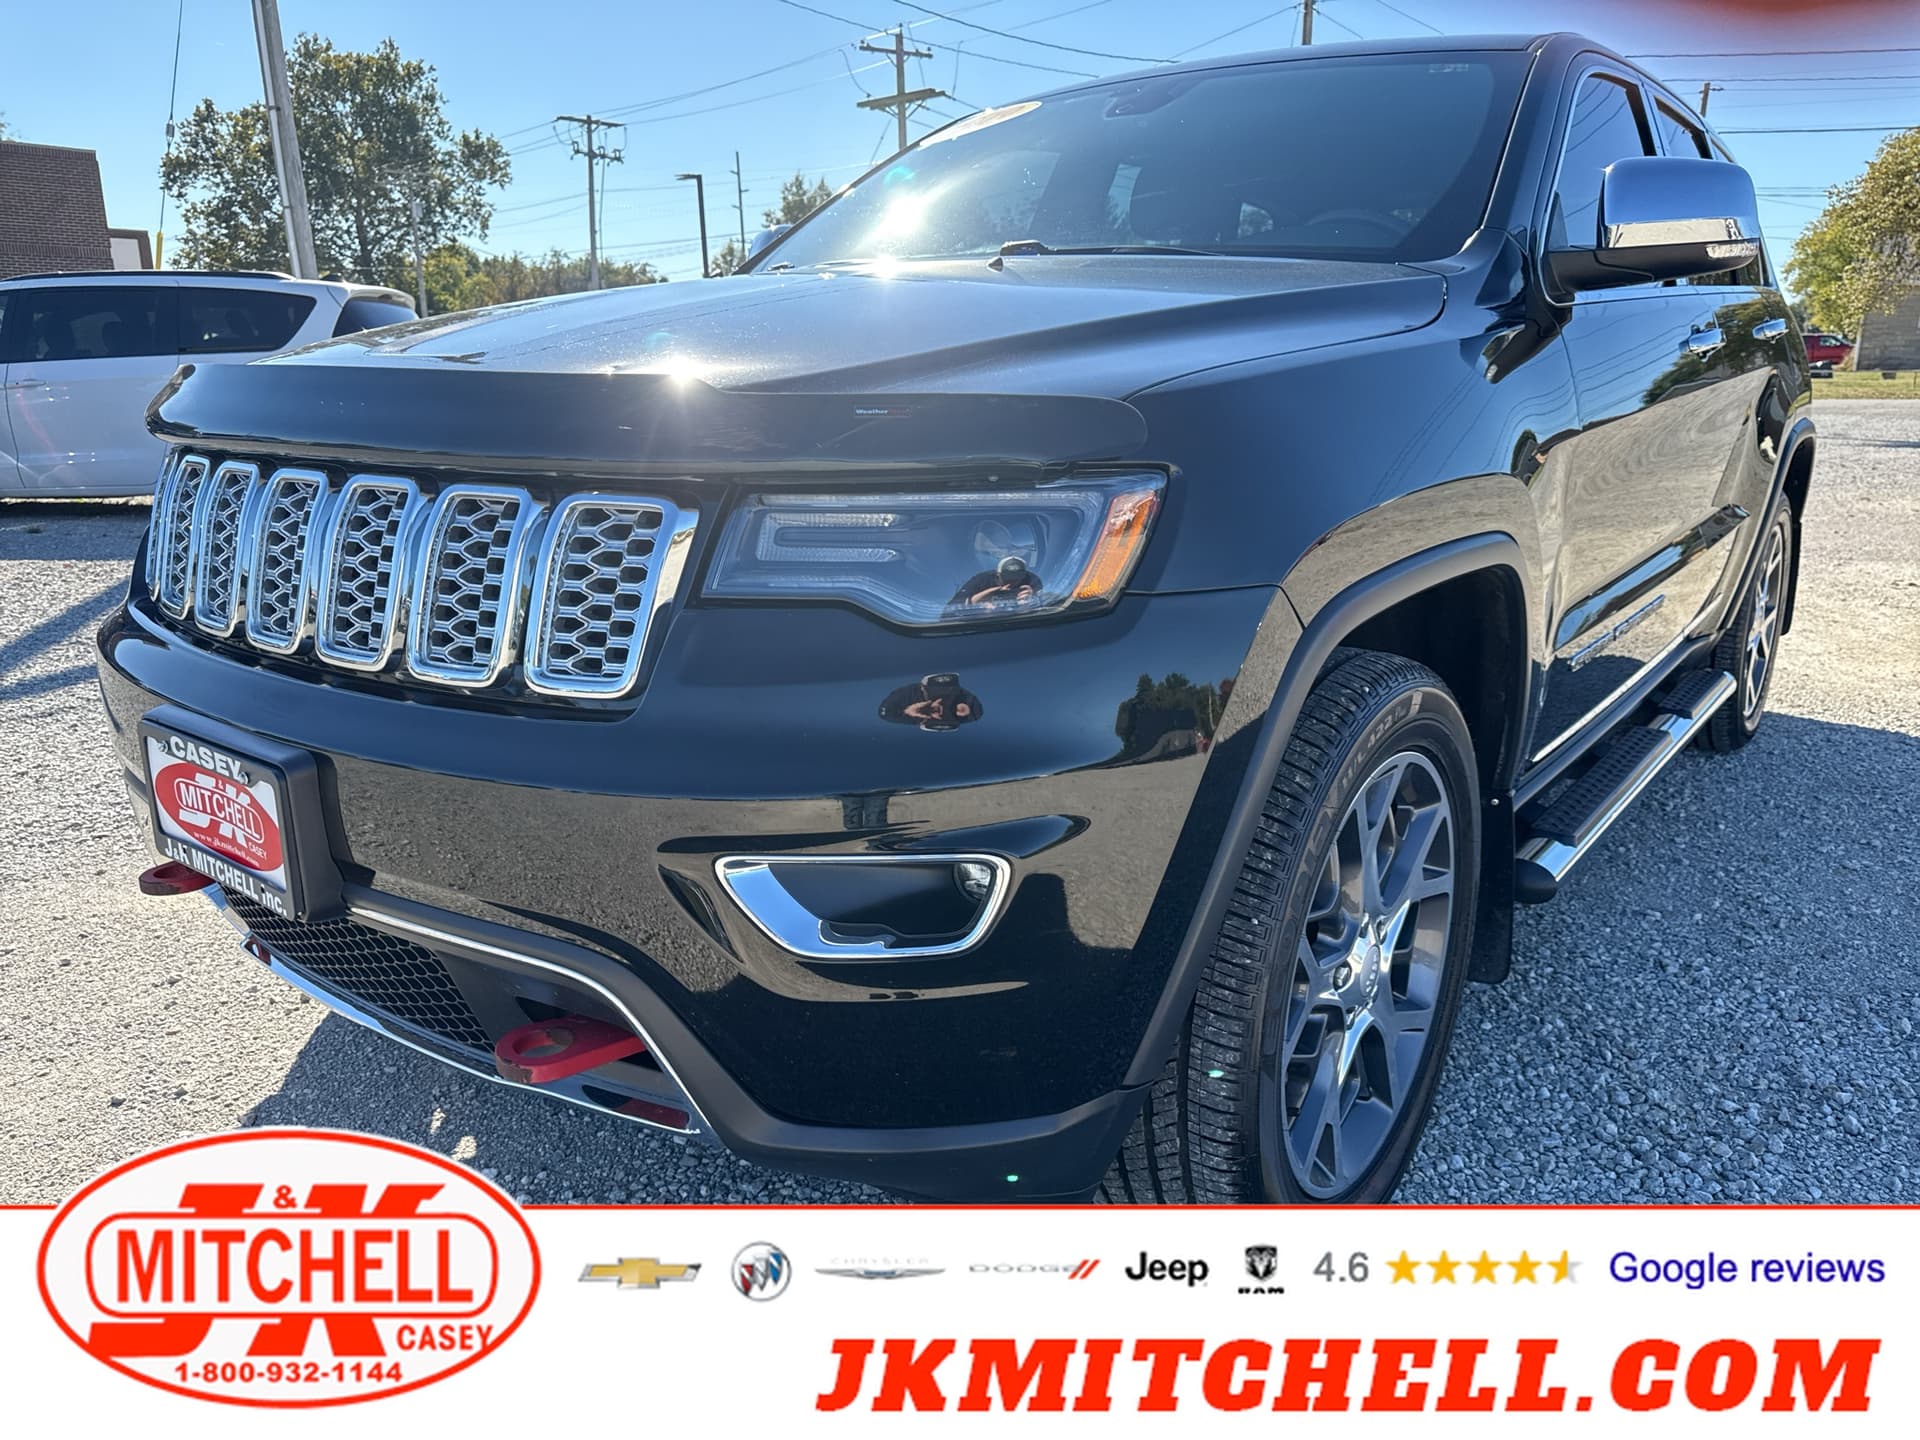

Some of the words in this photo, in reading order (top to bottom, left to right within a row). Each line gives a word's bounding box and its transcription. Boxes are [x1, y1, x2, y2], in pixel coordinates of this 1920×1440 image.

[169, 735, 242, 782] CASEY
[179, 782, 261, 840] MITCHELL
[191, 847, 259, 900] MITCHELL
